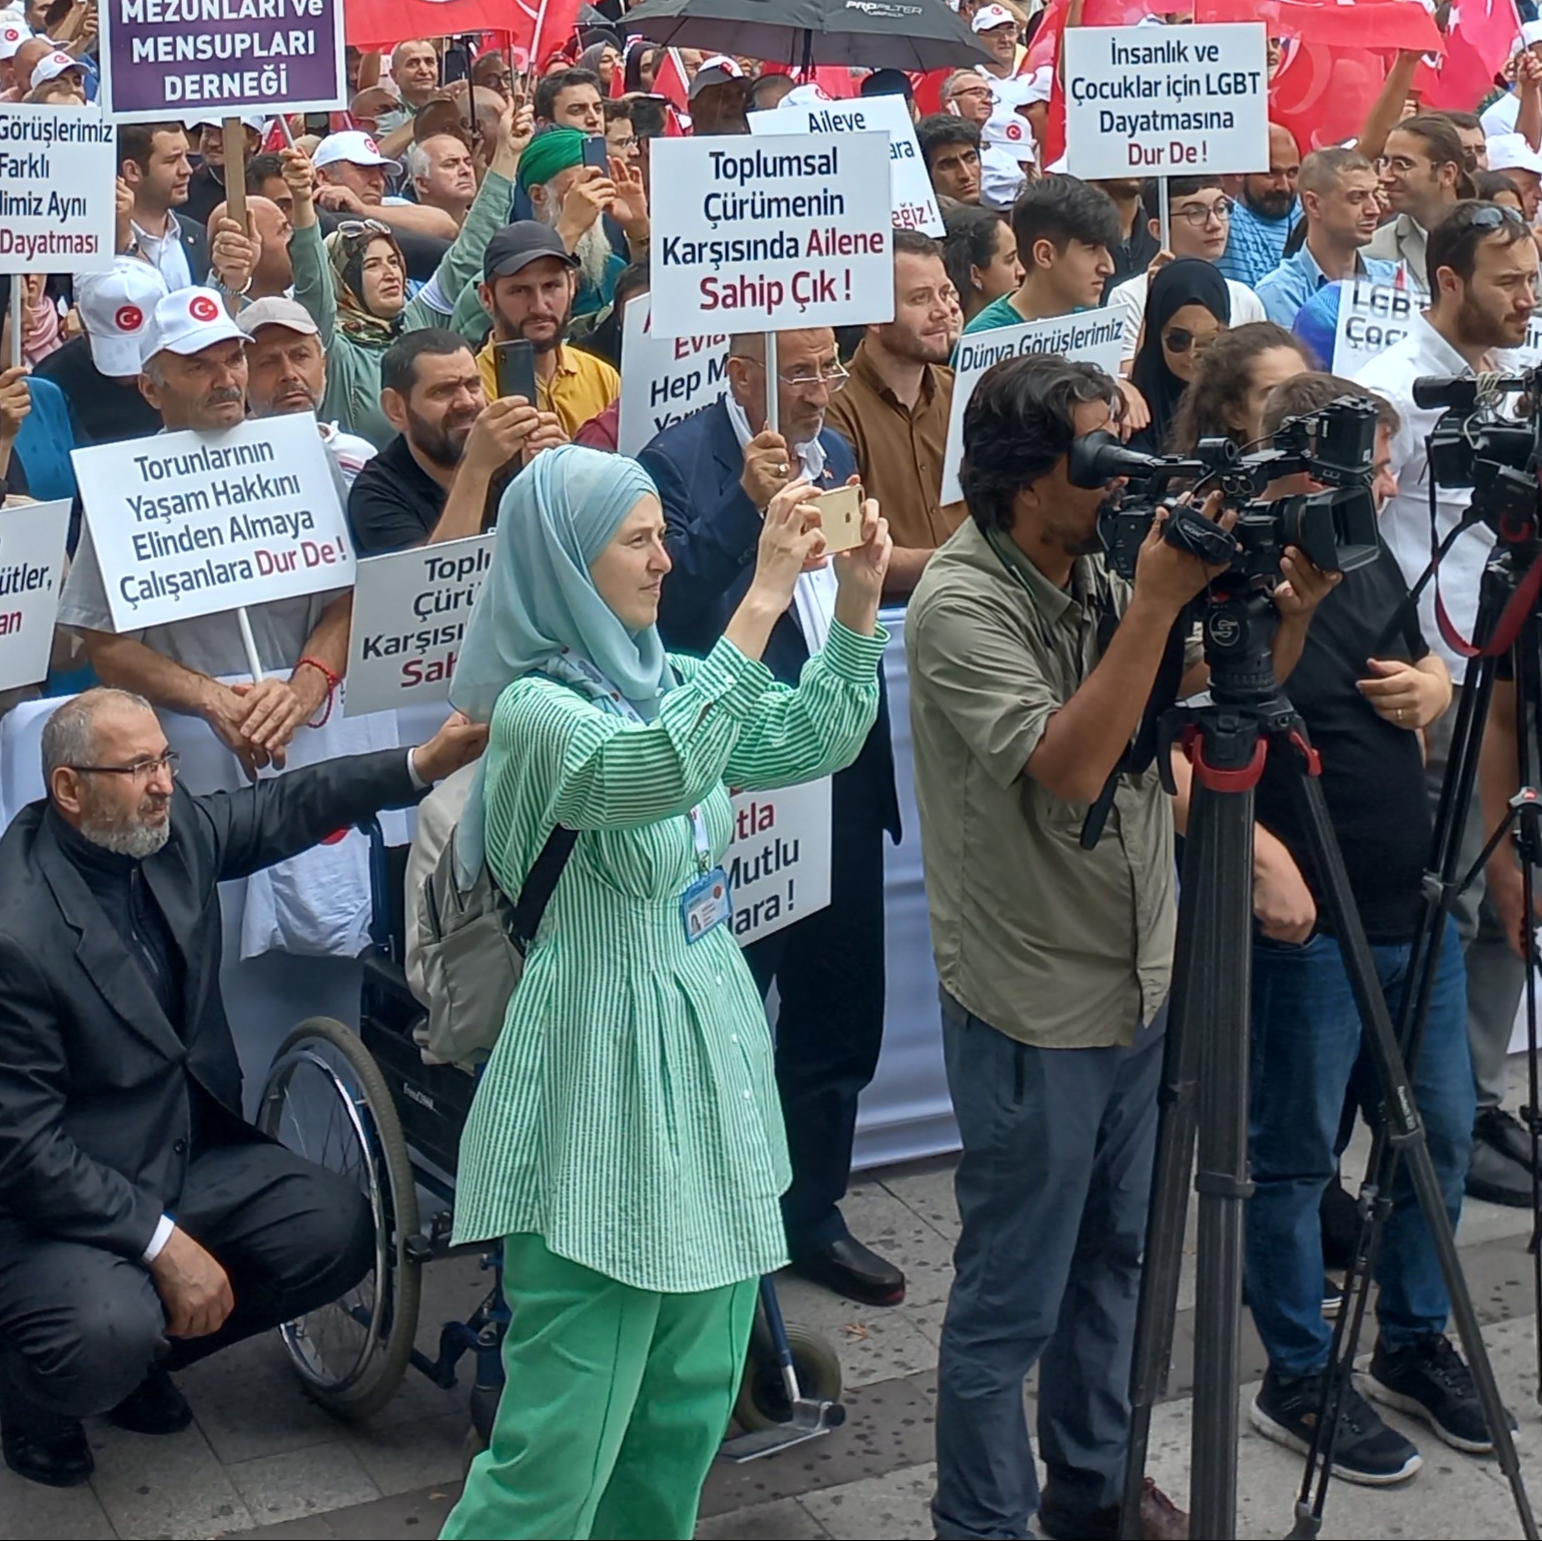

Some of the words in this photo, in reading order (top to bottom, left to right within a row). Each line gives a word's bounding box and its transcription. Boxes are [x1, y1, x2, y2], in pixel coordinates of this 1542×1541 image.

[132, 30, 315, 63] MENSUPLARI
[1111, 38, 1189, 65] İnsanlık
[1194, 44, 1219, 62] ve
[164, 64, 288, 101] DERNEĞİ
[1072, 75, 1161, 106] Çocuklar
[1166, 74, 1200, 103] için
[1206, 72, 1260, 96] LGBT
[1100, 110, 1234, 138] Dayatmasına
[709, 146, 838, 186] Toplumsal
[1128, 143, 1164, 166] Dur
[1169, 142, 1197, 163] De
[47, 191, 86, 223] Aynı
[703, 188, 844, 229] Çürümenin
[0, 229, 98, 261] Dayatması
[663, 231, 799, 271] Karşısında
[805, 228, 884, 258] Ailene
[699, 273, 784, 315] Sahip
[791, 269, 837, 313] Çık
[651, 370, 701, 407] Hep
[134, 441, 274, 482] Torunlarının
[125, 488, 209, 524] Yaşam
[211, 473, 301, 508] Hakkını
[132, 524, 224, 561] Elinden
[230, 509, 315, 543] Almaya
[120, 558, 253, 610] Çalışanlara
[255, 549, 297, 576] Dur
[300, 541, 336, 567] De
